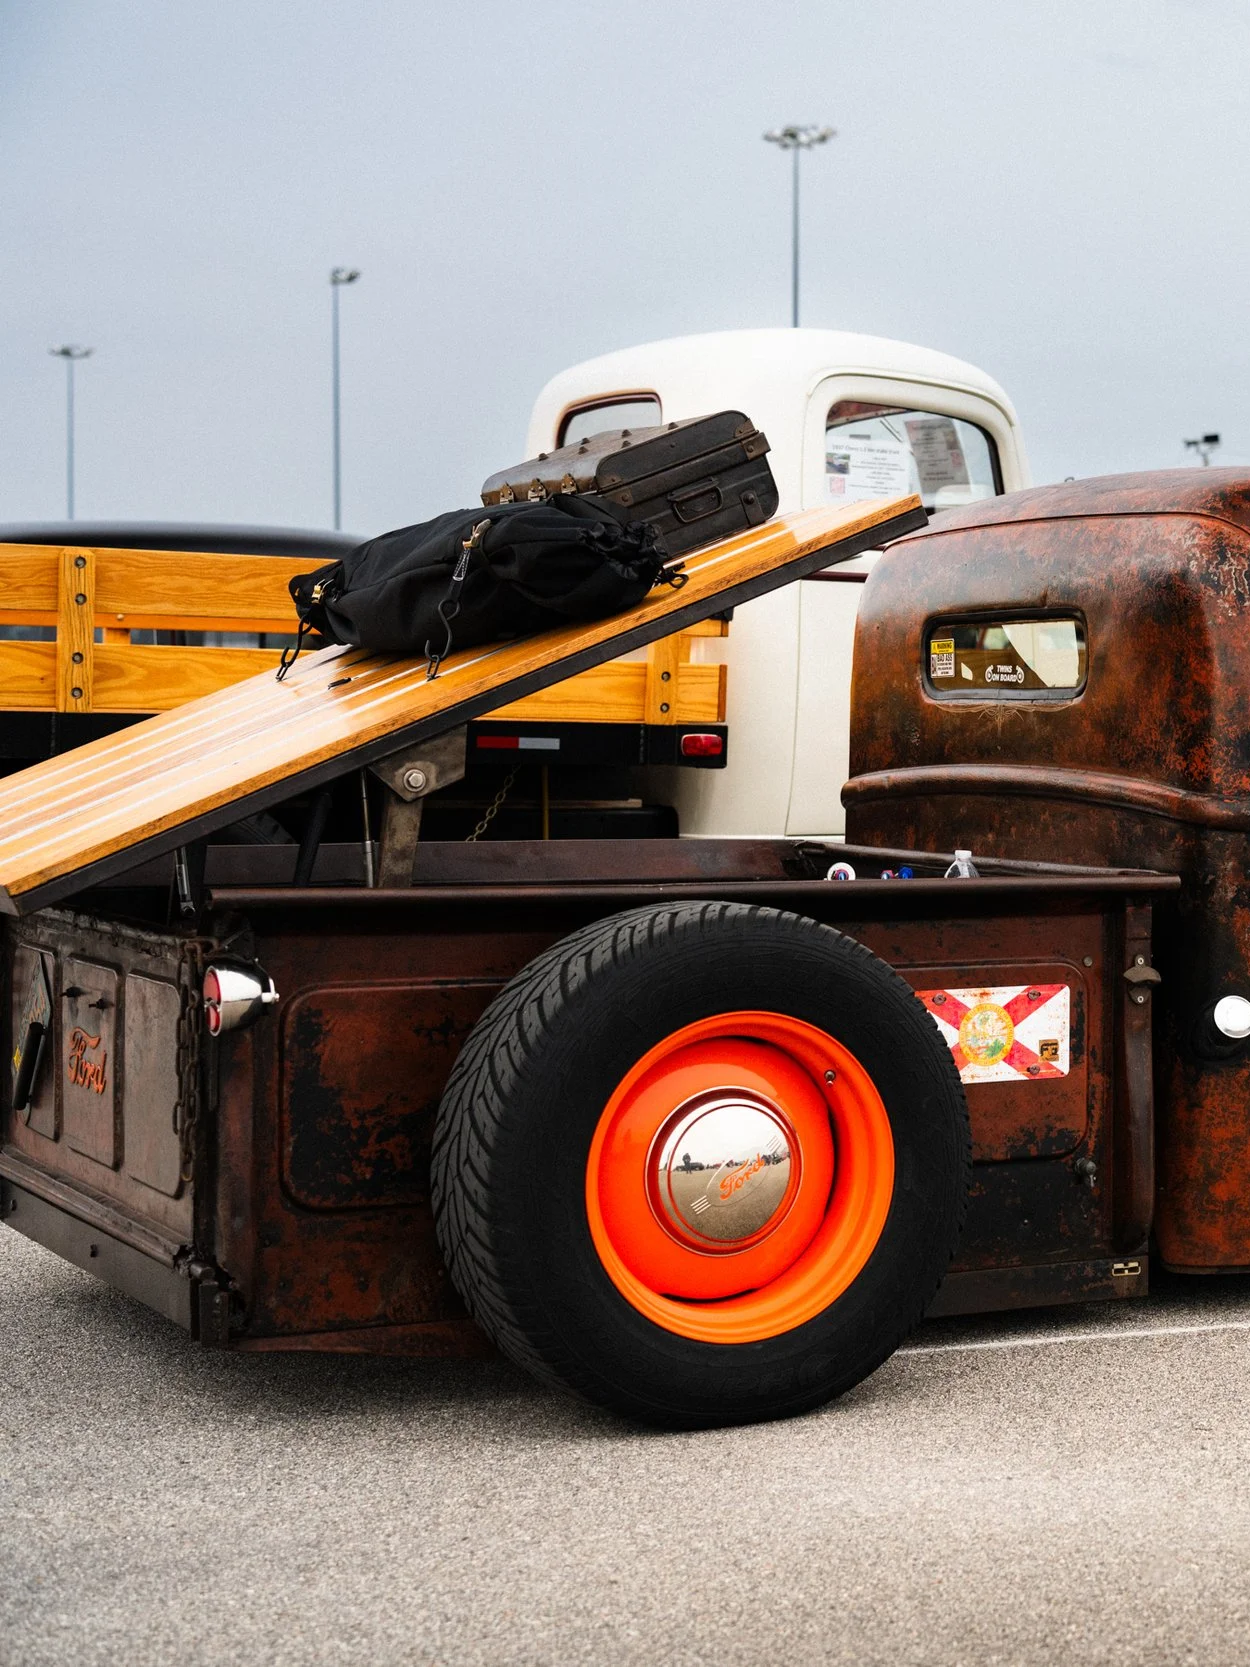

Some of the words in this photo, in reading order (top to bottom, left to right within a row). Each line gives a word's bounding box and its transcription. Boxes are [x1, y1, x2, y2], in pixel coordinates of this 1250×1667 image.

[992, 673, 999, 681] ON
[1000, 674, 1017, 682] BOARD
[997, 665, 1012, 673] TWINS
[68, 1026, 107, 1095] Ford
[719, 1152, 766, 1200] Ford
